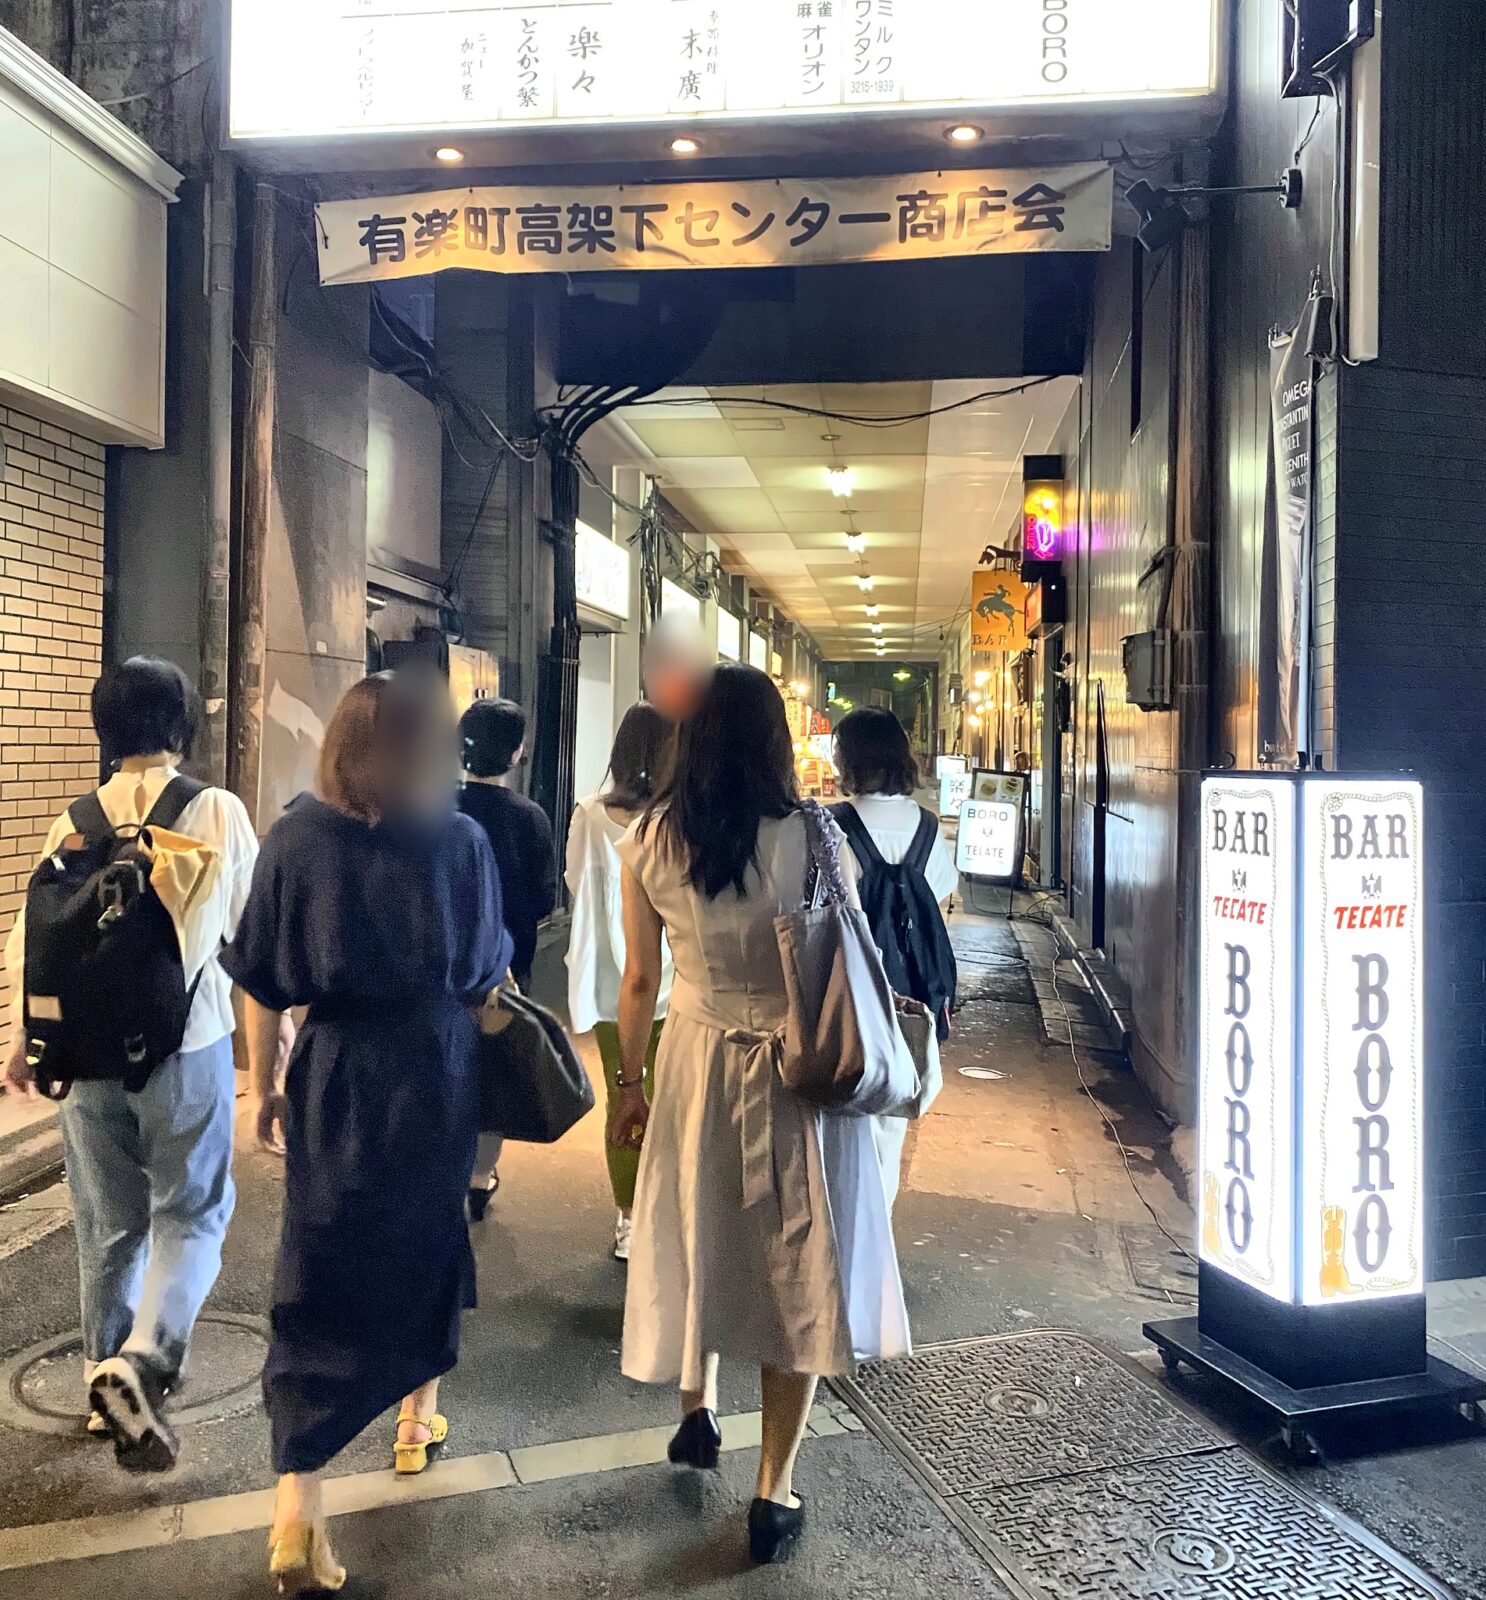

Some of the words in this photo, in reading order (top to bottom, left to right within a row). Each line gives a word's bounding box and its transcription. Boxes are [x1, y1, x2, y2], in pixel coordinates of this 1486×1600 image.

[797, 1, 832, 19] 麻雀
[854, 0, 871, 75] ワンタン
[876, 0, 893, 74] ミルク
[516, 18, 540, 108] とんかつ繁
[566, 26, 603, 94] 楽々
[676, 28, 703, 101] 末廣
[801, 24, 827, 95] オリオン
[850, 80, 894, 94] 3215-1939
[358, 183, 1066, 265] 有楽町高架下センター商店会
[972, 634, 1008, 646] BAR
[967, 808, 1008, 822] BORO
[1212, 809, 1270, 857] BAR
[1330, 814, 1409, 860] BAR
[1213, 895, 1267, 924] TECATE
[1333, 904, 1408, 929] TECATE
[1223, 942, 1255, 1255] BORO
[1351, 952, 1395, 1274] BORO
